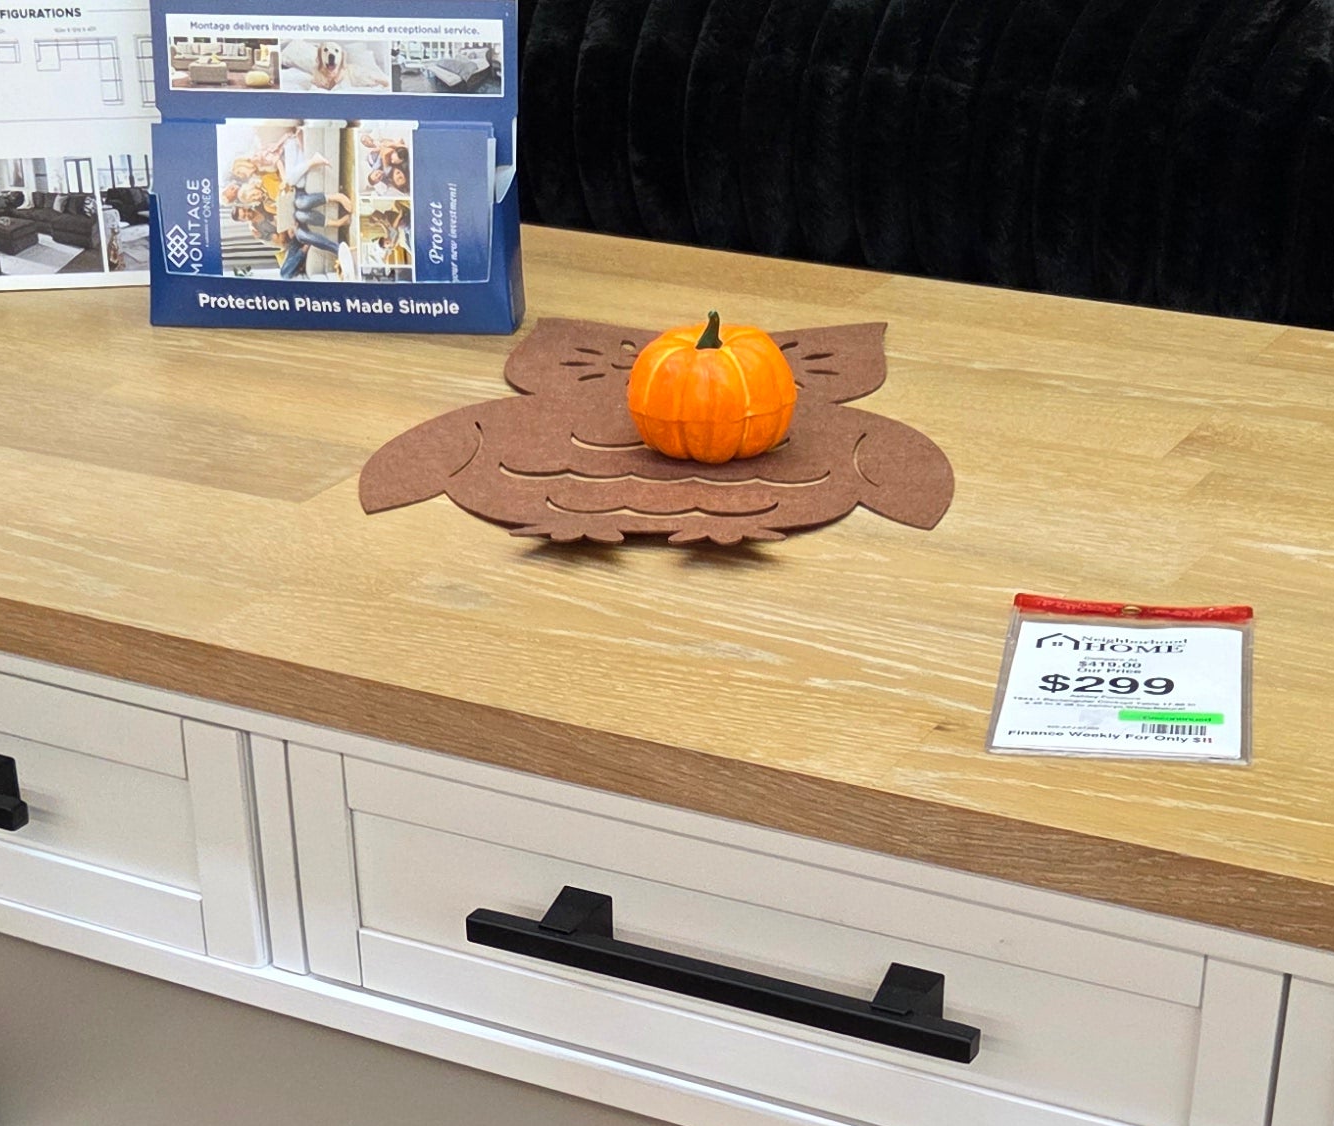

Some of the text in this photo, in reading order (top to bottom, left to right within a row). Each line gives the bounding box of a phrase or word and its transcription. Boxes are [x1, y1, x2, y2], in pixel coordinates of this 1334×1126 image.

[190, 21, 480, 36] Montage delivers innovative solutions and exceptional service.
[201, 178, 212, 218] ONE80
[447, 183, 458, 239] investment!
[187, 179, 203, 275] MONTAGE
[428, 201, 444, 265] Protect
[450, 240, 458, 261] new
[198, 293, 460, 320] Protection Plans Made Simple
[1083, 642, 1185, 653] HOME
[1078, 661, 1142, 669] $419.00
[1038, 674, 1175, 695] $299
[1007, 729, 1064, 737] Finance
[1069, 731, 1120, 740] Weekly
[1154, 735, 1188, 744] Only
